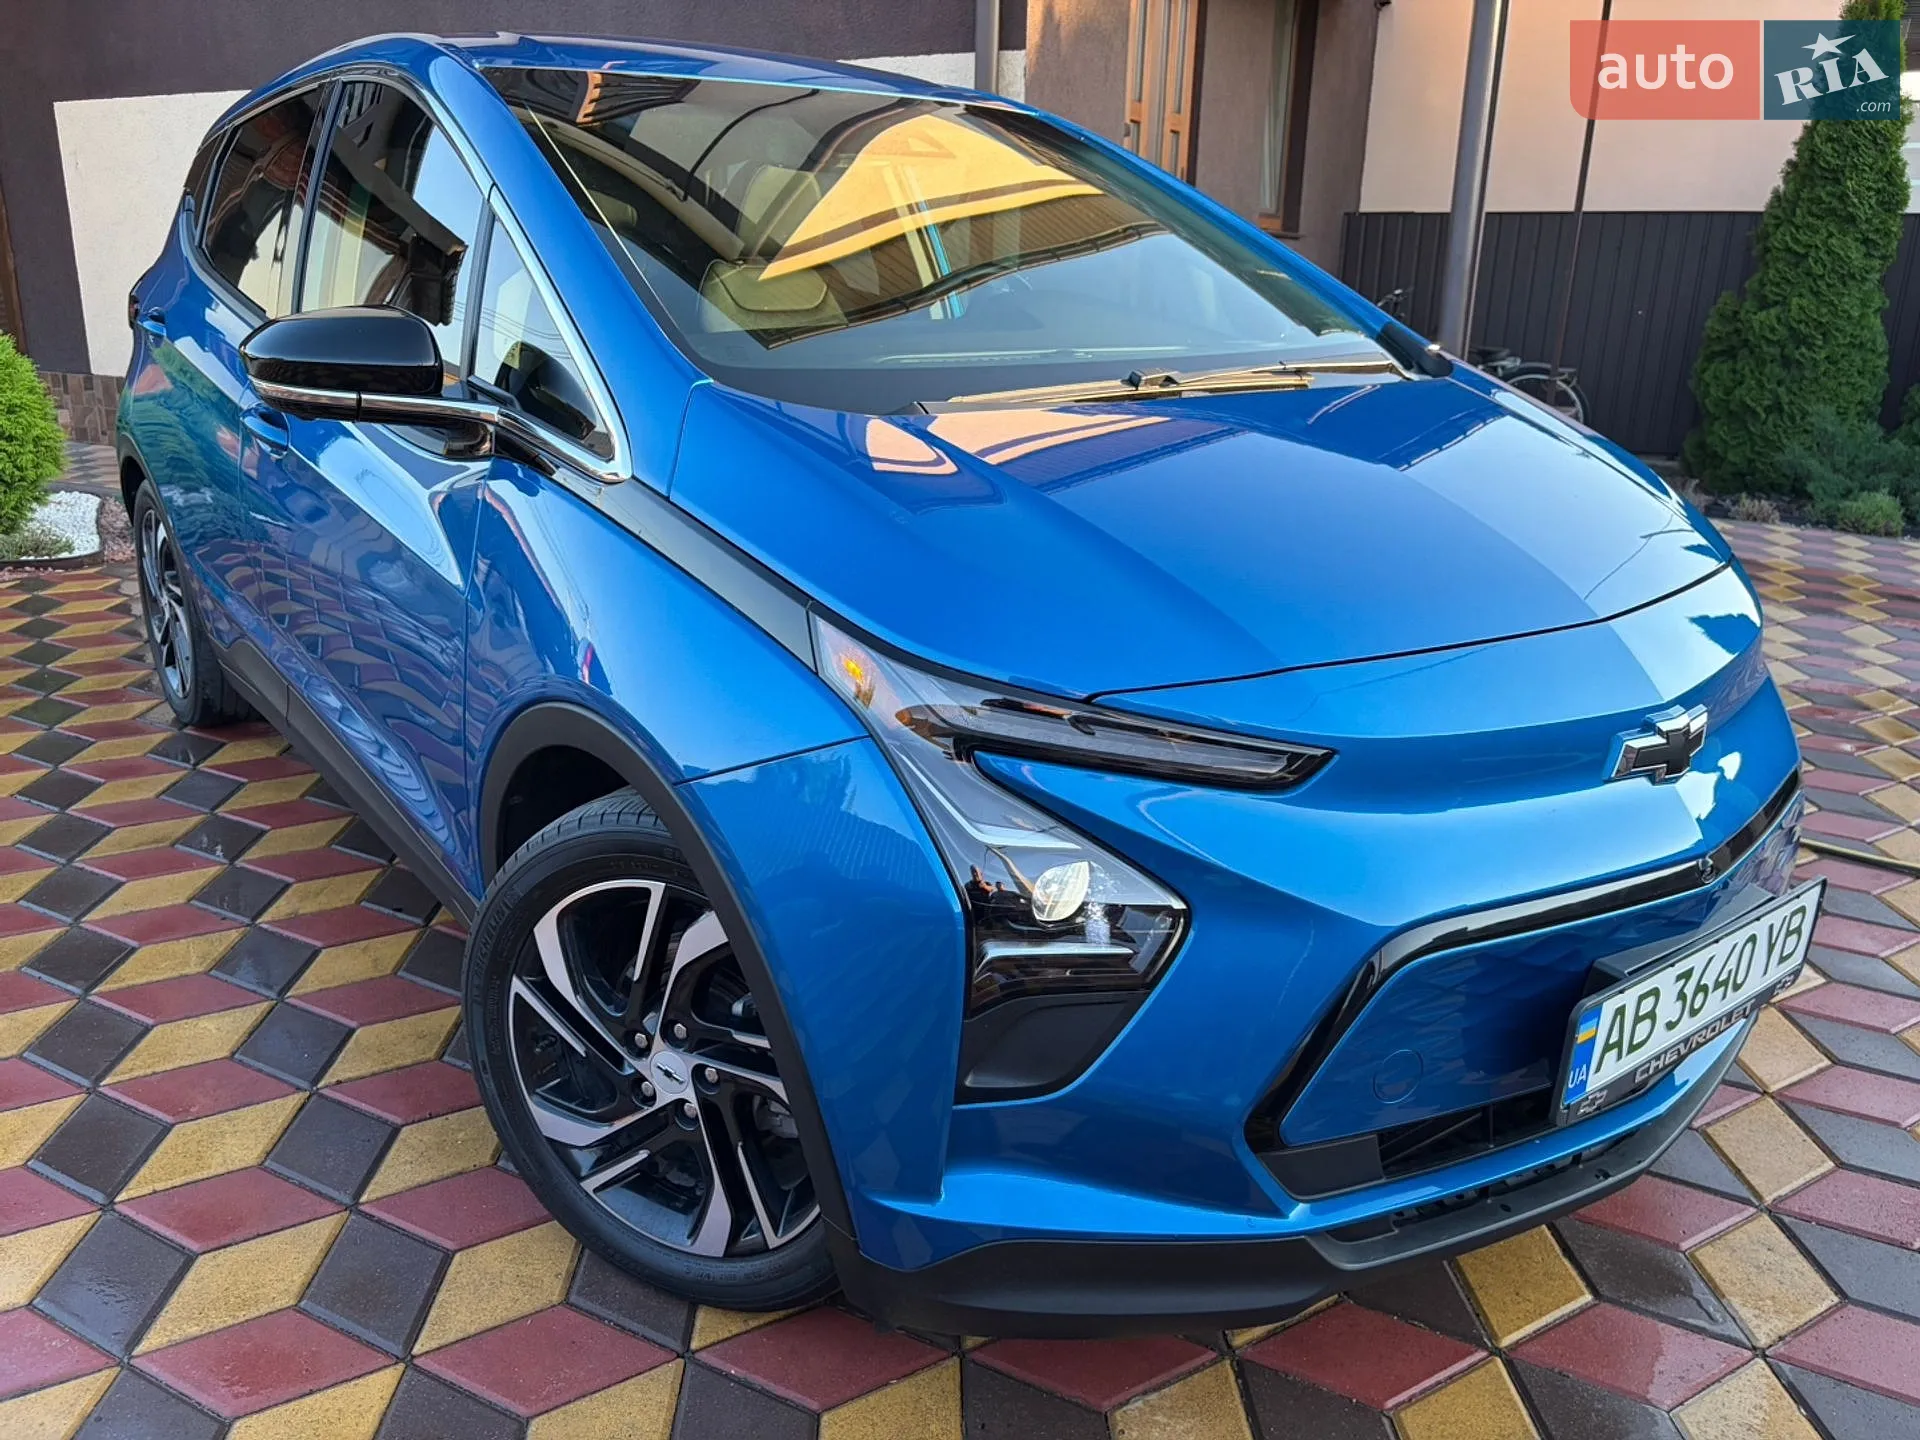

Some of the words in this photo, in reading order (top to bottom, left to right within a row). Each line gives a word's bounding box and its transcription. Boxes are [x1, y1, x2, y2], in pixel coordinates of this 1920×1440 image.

[1594, 986, 1661, 1075] AB
[1665, 932, 1757, 1033] 3640
[1761, 904, 1807, 978] YB
[1568, 1063, 1587, 1088] UA
[1635, 998, 1756, 1083] CHEVROLET
